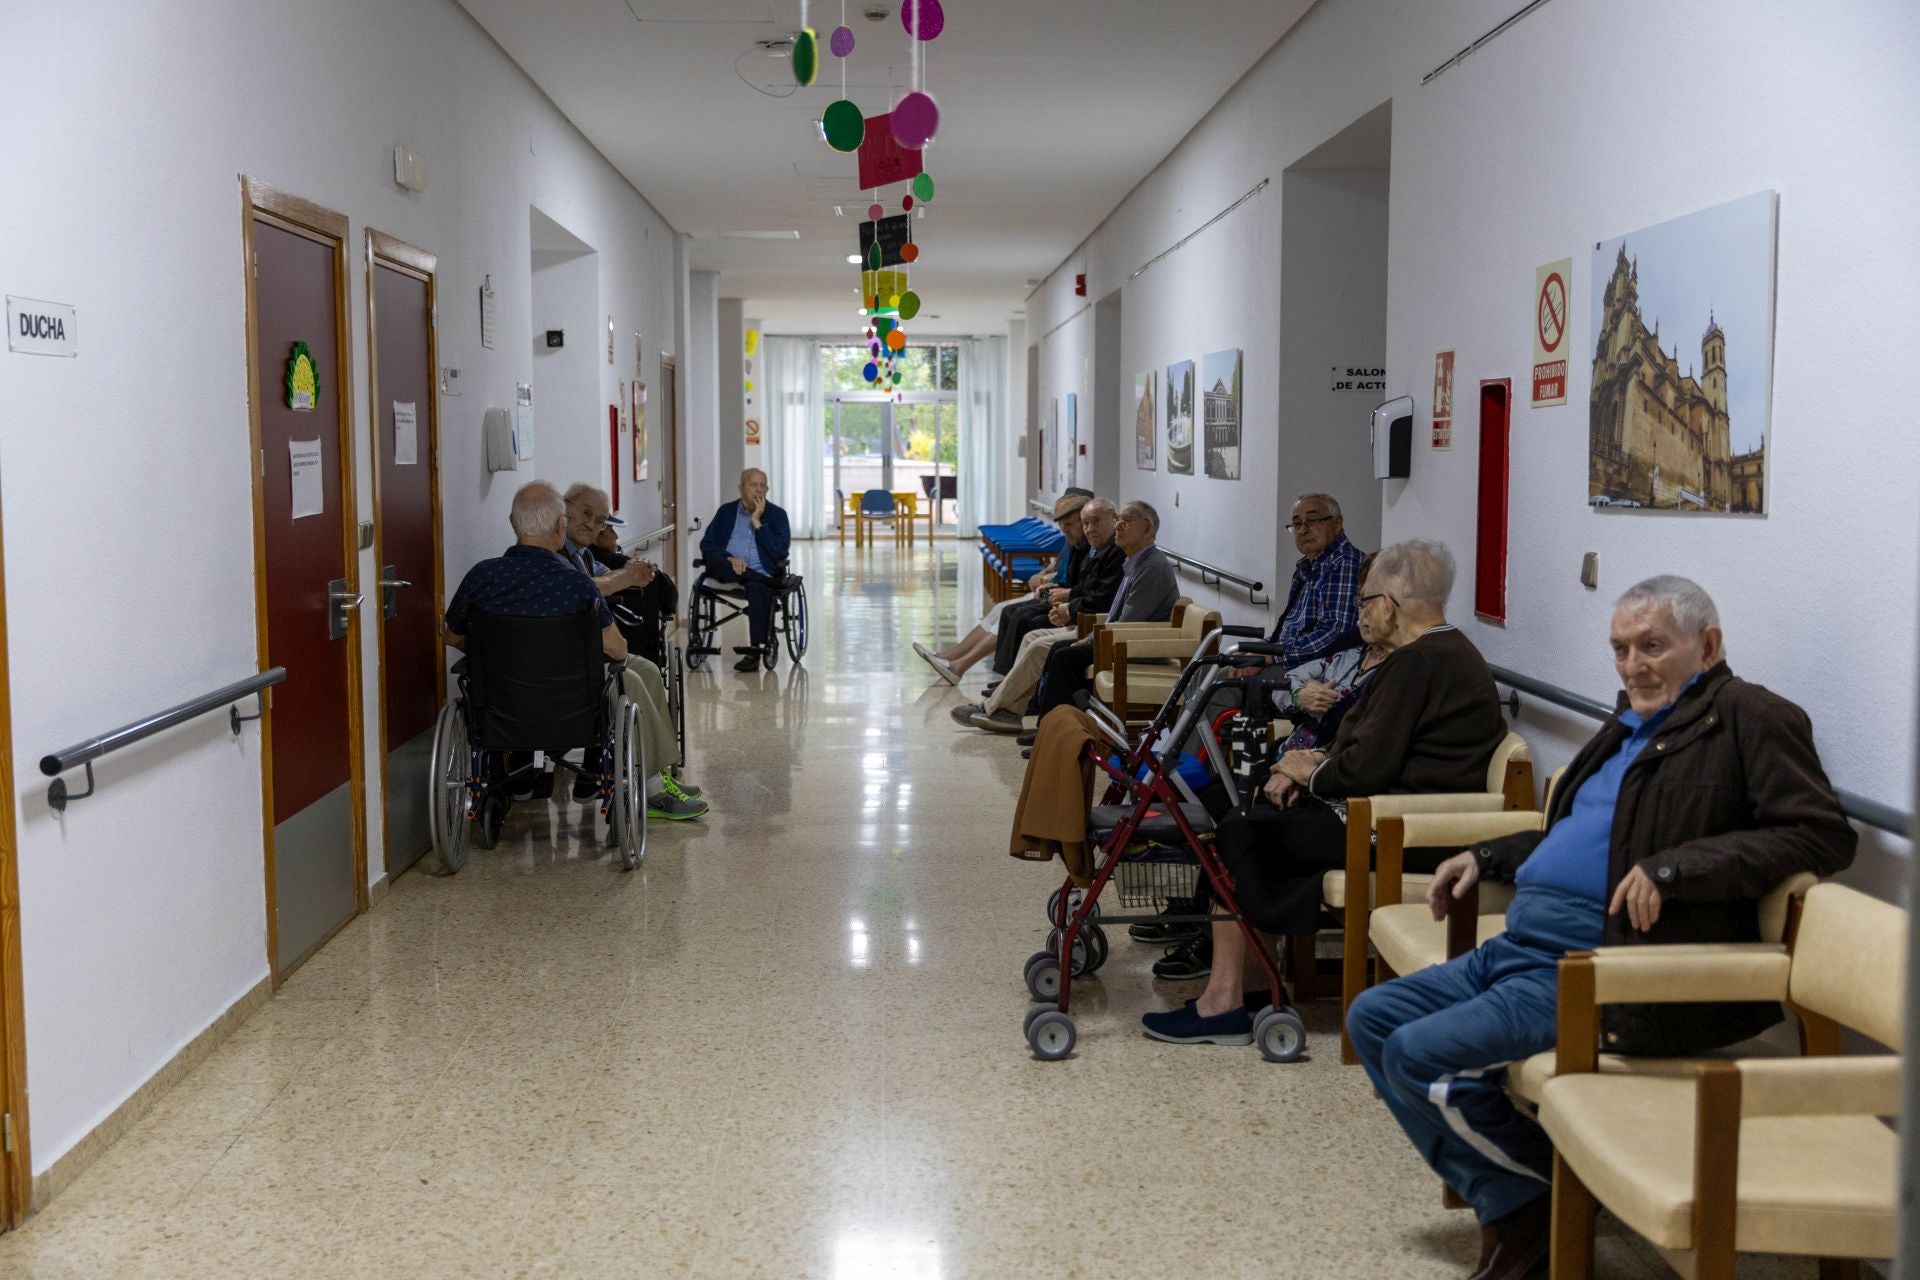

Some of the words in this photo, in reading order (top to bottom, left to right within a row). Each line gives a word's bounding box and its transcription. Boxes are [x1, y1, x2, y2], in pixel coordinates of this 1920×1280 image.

[20, 313, 65, 340] DUCHA
[1534, 362, 1565, 380] PROHIBIDO
[1336, 381, 1353, 390] DE
[1540, 383, 1559, 399] FUMAR
